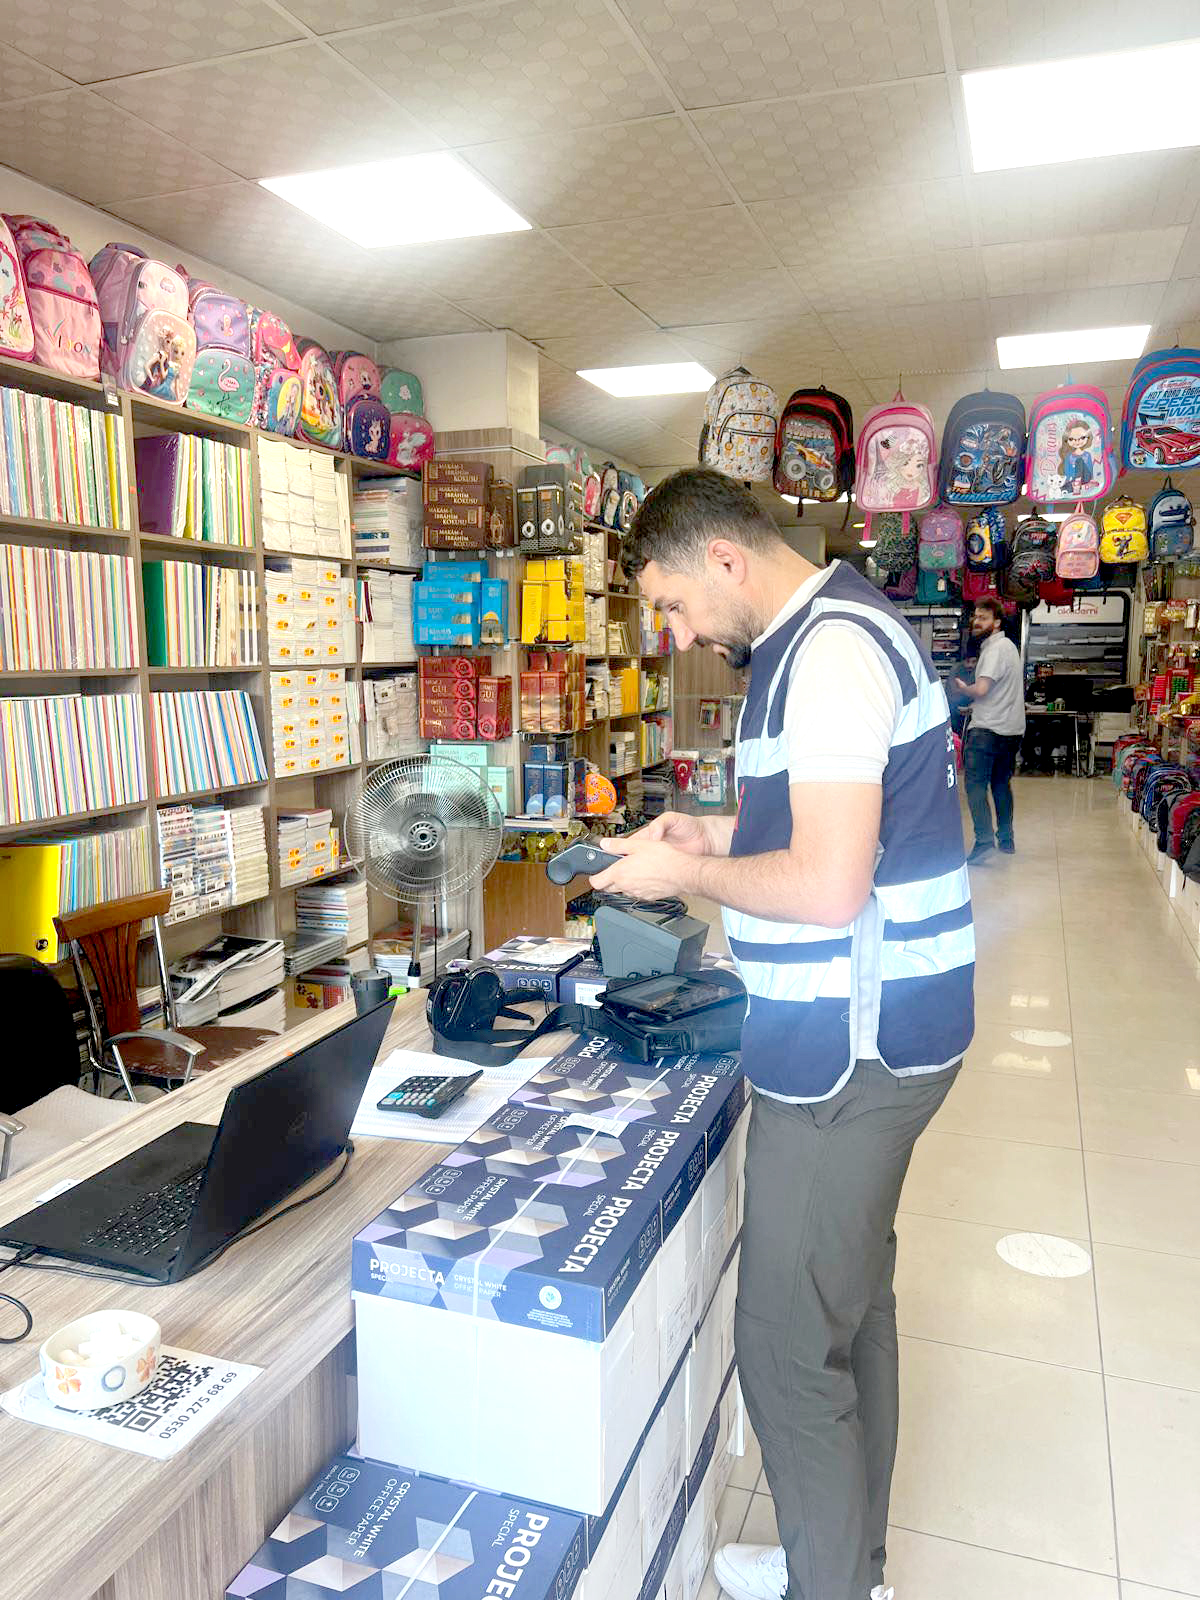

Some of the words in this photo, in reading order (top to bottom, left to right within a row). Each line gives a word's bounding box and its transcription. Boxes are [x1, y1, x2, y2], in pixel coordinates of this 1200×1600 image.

[1057, 607, 1098, 615] akemi
[670, 1074, 718, 1123] PROJECTA
[637, 1128, 657, 1148] SPECIAL
[621, 1130, 680, 1190] PROJECTA
[472, 1175, 496, 1196] OFFICE
[480, 1177, 509, 1201] CRYSTAL
[456, 1194, 479, 1214] PAPER
[462, 1200, 488, 1221] WHITE
[583, 1194, 606, 1217] SPECIAL
[558, 1196, 633, 1273] PROJECTA
[370, 1258, 446, 1286] PROJECTA
[454, 1275, 484, 1288] CRYSTL
[484, 1280, 507, 1291] WHITE
[454, 1282, 476, 1291] OFFIC
[159, 1415, 190, 1439] 0530
[186, 1396, 210, 1414] 275
[207, 1384, 224, 1395] 68
[221, 1372, 237, 1383] 69
[369, 1478, 398, 1512] OFFICE
[377, 1481, 411, 1521] CRYSTAL
[345, 1513, 375, 1545] PAPER
[353, 1524, 384, 1557] WHITE
[491, 1508, 520, 1547] SPECIAL
